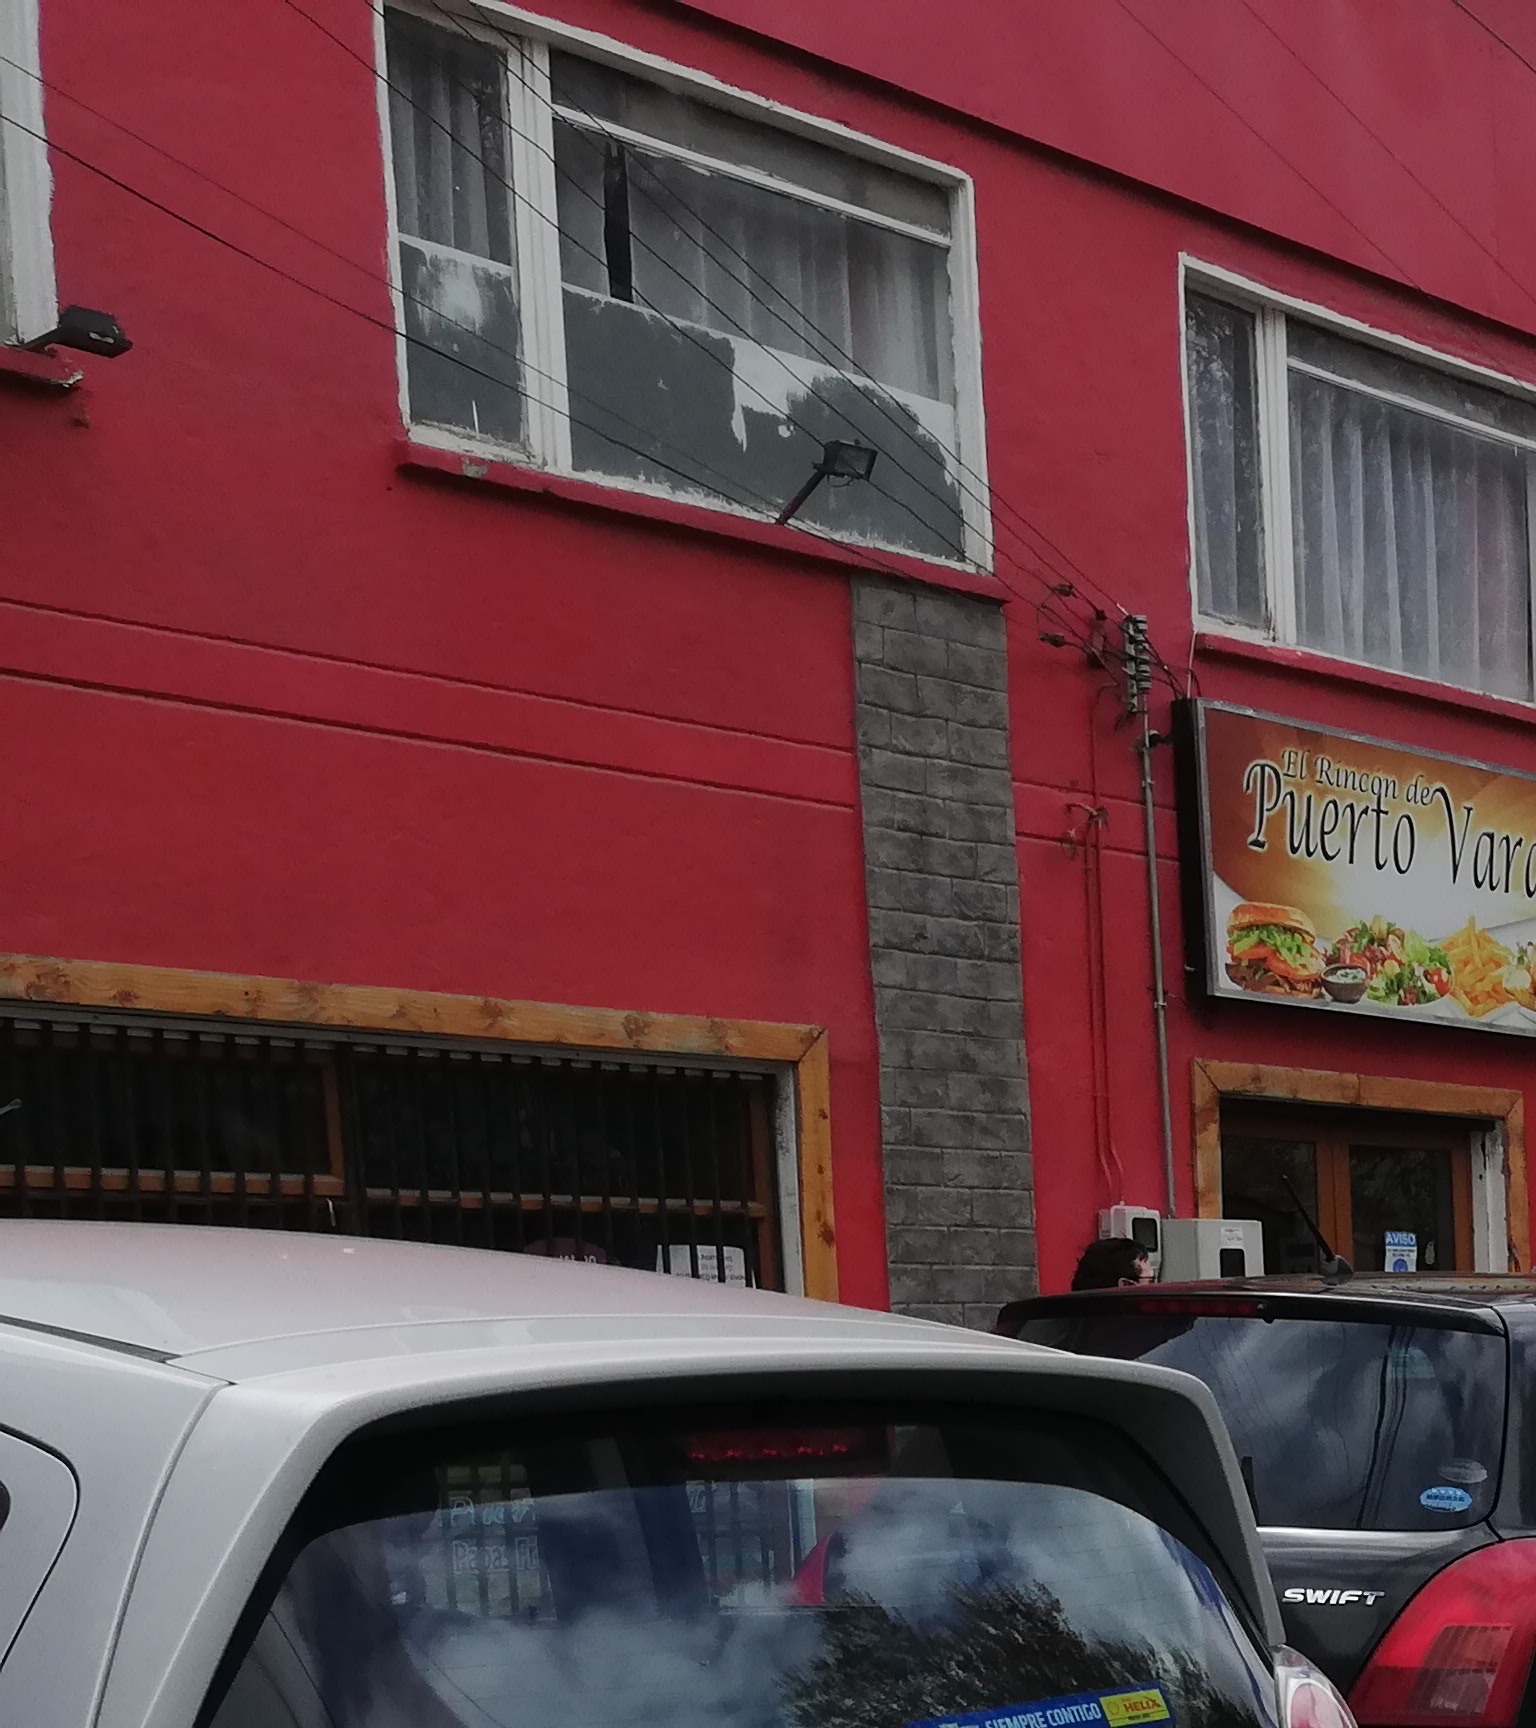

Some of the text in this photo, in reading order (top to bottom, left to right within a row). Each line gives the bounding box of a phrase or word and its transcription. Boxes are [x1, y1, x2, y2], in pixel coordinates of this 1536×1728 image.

[1281, 749, 1308, 779] El
[1406, 775, 1432, 806] de
[1243, 761, 1417, 875] Puerto
[1386, 1231, 1416, 1245] AVISO
[1282, 1588, 1385, 1606] SWIFT
[1122, 1695, 1162, 1713] HELIX
